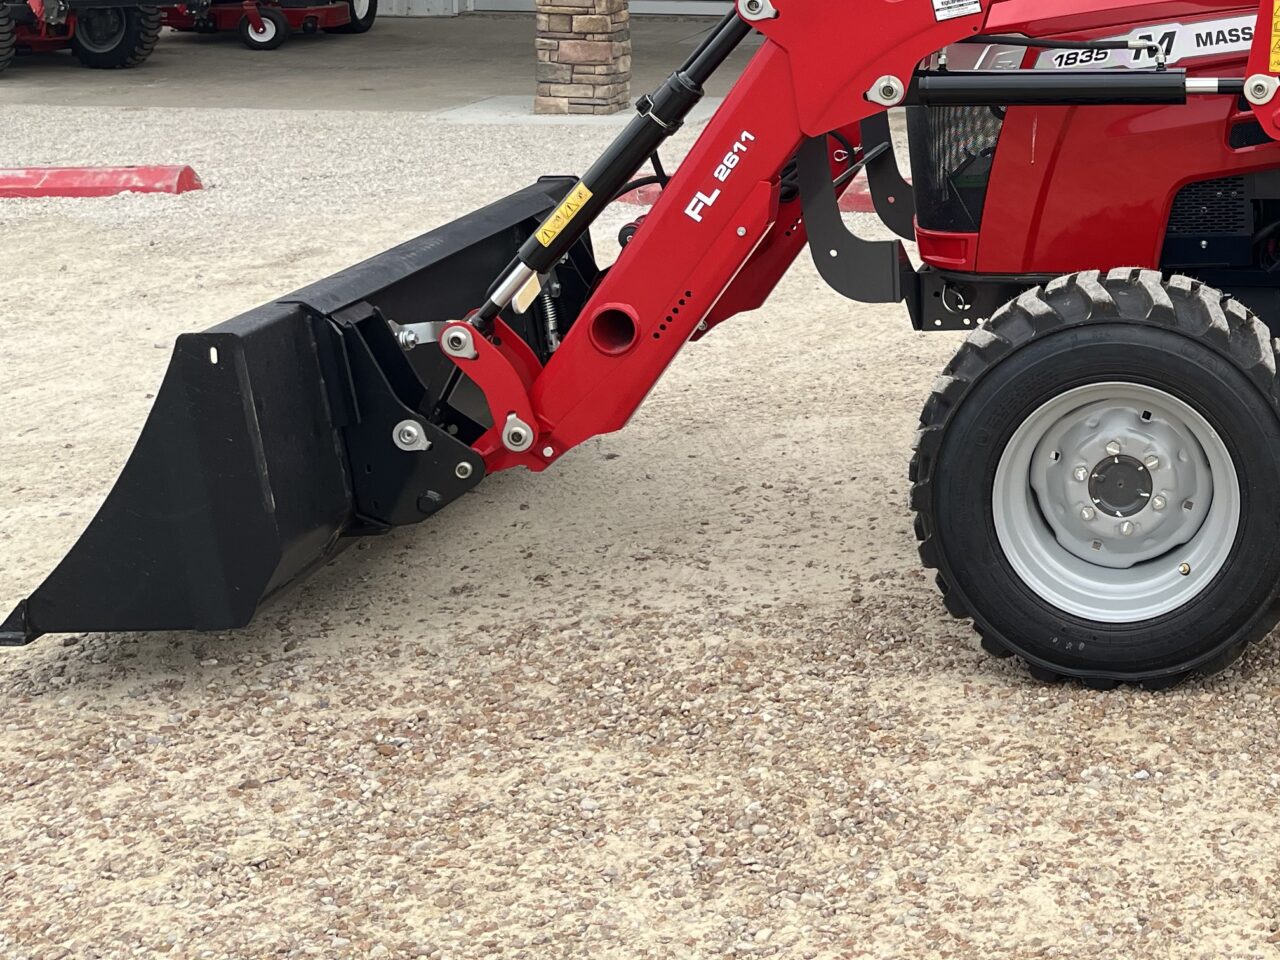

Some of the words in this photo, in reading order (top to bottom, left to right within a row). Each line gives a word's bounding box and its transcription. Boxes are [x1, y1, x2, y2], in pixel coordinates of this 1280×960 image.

[1053, 48, 1110, 68] 1835
[1195, 26, 1254, 48] MASS
[684, 188, 721, 222] FL
[713, 130, 756, 182] 2611
